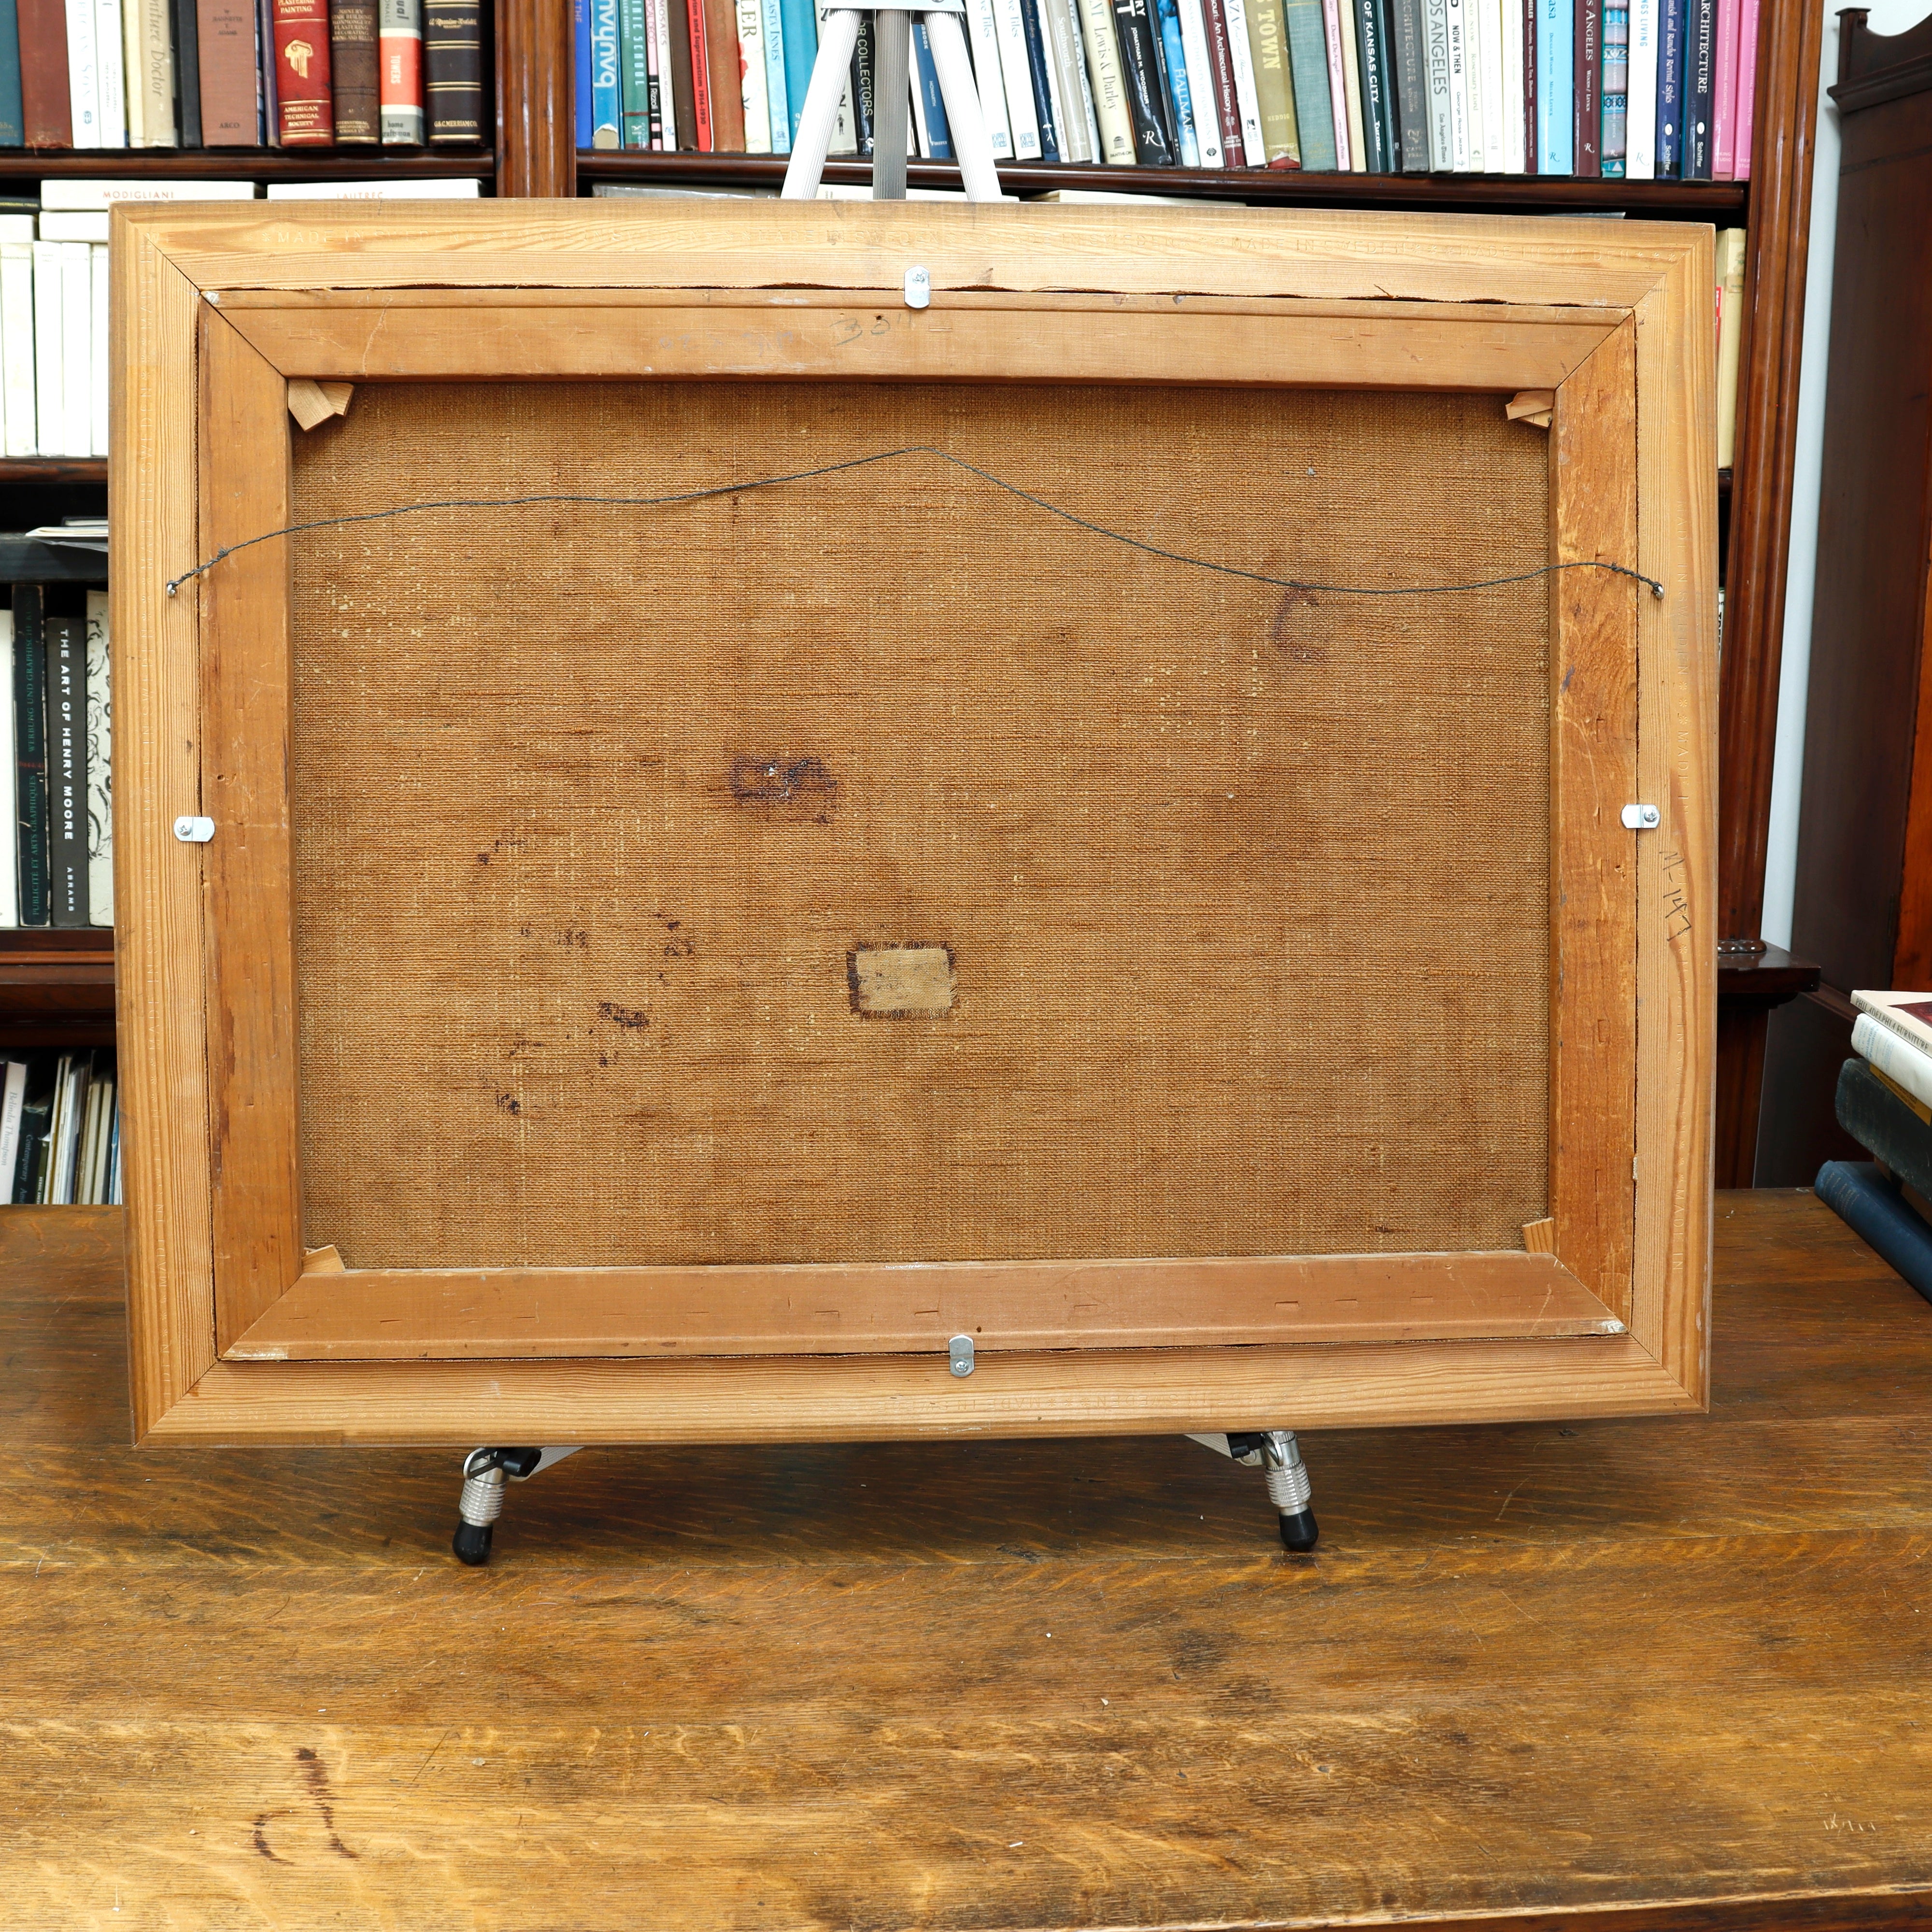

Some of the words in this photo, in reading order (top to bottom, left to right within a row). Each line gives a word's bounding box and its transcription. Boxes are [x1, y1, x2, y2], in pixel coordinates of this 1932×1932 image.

[658, 0, 668, 45] MOSAICS
[740, 0, 757, 38] LER
[1364, 1, 1373, 18] OF
[1548, 0, 1557, 19] asa
[1640, 0, 1649, 15] NGS
[647, 22, 655, 44] DECO
[982, 14, 993, 38] Tiles
[1009, 14, 1021, 38] Tiles
[1214, 22, 1222, 34] An
[1257, 9, 1282, 69] TOWN
[1585, 10, 1596, 61] ANGELES
[1639, 19, 1648, 47] LIVING
[1667, 18, 1677, 32] and
[1056, 17, 1073, 68] Southworth
[1094, 27, 1110, 59] Lewis
[1365, 21, 1379, 71] KANSAS
[1431, 20, 1448, 95] ANGELES
[1667, 33, 1676, 57] Rancho
[1697, 0, 1711, 94] RCHITECTURE
[150, 50, 165, 97] Doctor
[390, 55, 401, 84] TOWERS
[633, 36, 645, 86] SCHOOL
[694, 35, 704, 87] Suprematism
[1100, 62, 1113, 71] &
[1131, 27, 1143, 60] JONATHAN
[1139, 70, 1151, 105] WOODHAM
[1216, 35, 1231, 84] Architectural
[1453, 54, 1462, 74] THEN
[1666, 59, 1676, 84] Revival
[857, 39, 874, 116] COLLECTORS
[1102, 75, 1119, 110] Darley
[1368, 74, 1380, 103] CITY
[650, 87, 658, 110] Rizzoli
[698, 90, 707, 125] 1914-1930
[929, 81, 938, 107] HOWARTH
[1175, 68, 1195, 141] HALLMARK
[1223, 84, 1233, 113] History
[1662, 85, 1676, 104] Styles
[1664, 145, 1673, 171] Schiffer
[1696, 142, 1704, 168] Schiffer
[102, 191, 175, 199] MODIGLIANI
[60, 629, 69, 658] THE
[60, 665, 70, 695] ART
[61, 701, 71, 721] OF
[62, 727, 72, 779] HENRY
[28, 775, 38, 832] GRAPHIQUES
[63, 786, 73, 840] MOORE
[30, 834, 38, 855] ARTS
[31, 857, 39, 868] ET
[31, 872, 40, 915] PUBLICITÉ
[66, 867, 74, 912] ABRAMS
[1855, 997, 1896, 1031] PHILADELPHIA
[1895, 1023, 1930, 1053] FURNITURE
[6, 1091, 18, 1123] Belinda
[1, 1125, 14, 1166] Thompson
[19, 1134, 33, 1182] Contemporary
